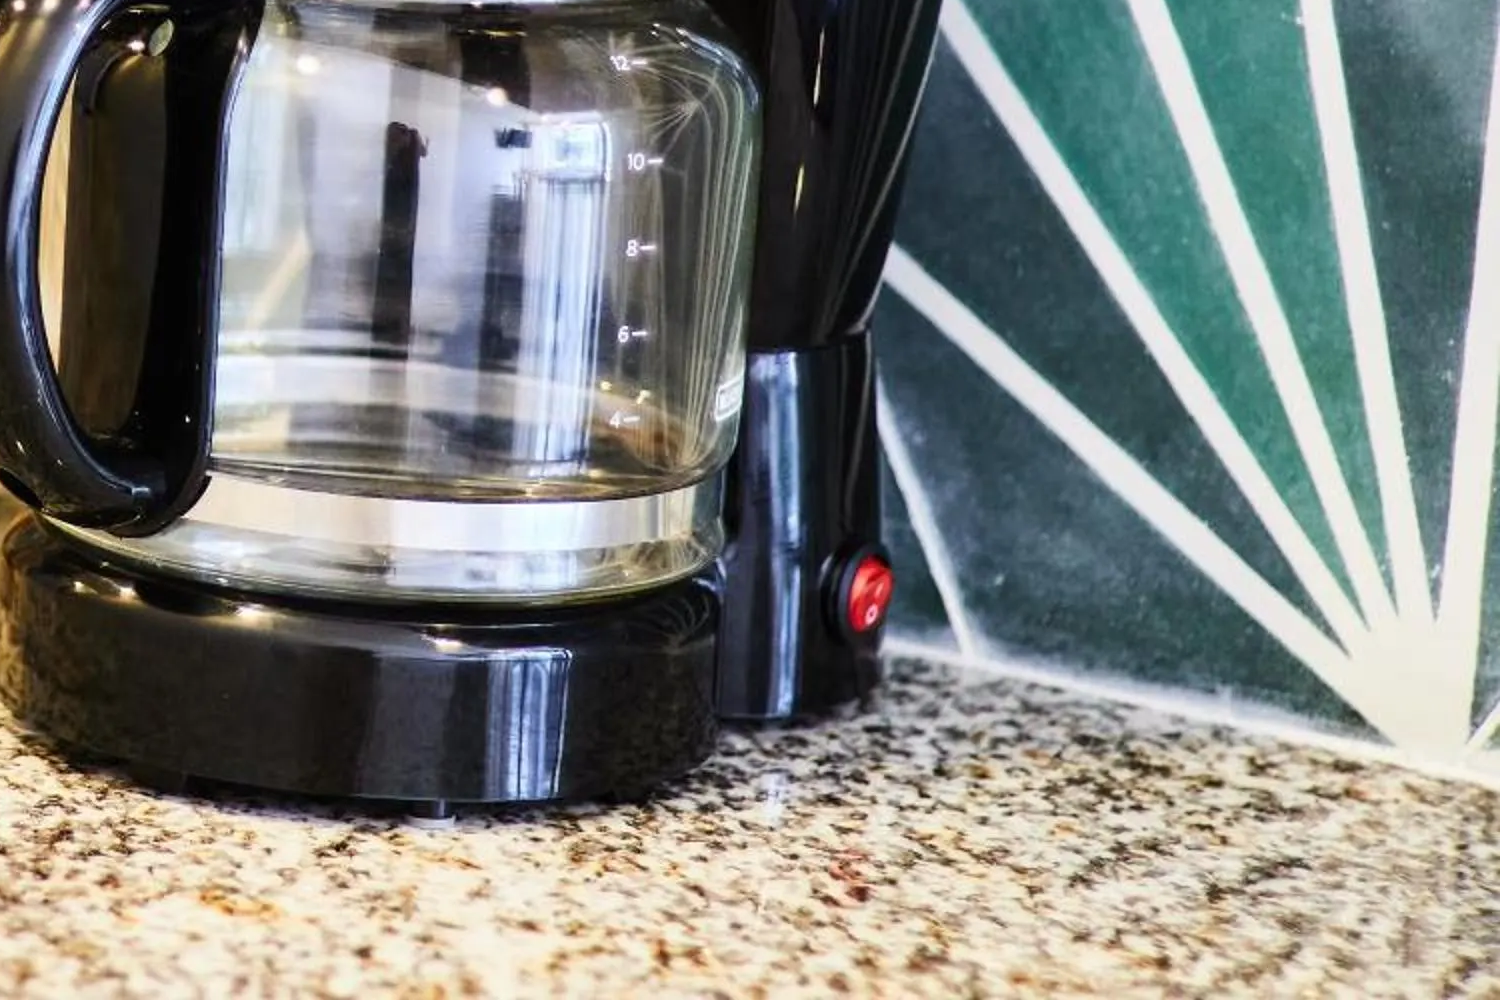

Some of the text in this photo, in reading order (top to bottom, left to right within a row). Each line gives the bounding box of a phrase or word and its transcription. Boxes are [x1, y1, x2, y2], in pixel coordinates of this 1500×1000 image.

[610, 55, 631, 71] 12
[627, 152, 645, 171] 10
[626, 239, 638, 257] 8
[618, 325, 629, 343] 6
[609, 411, 621, 429] 4
